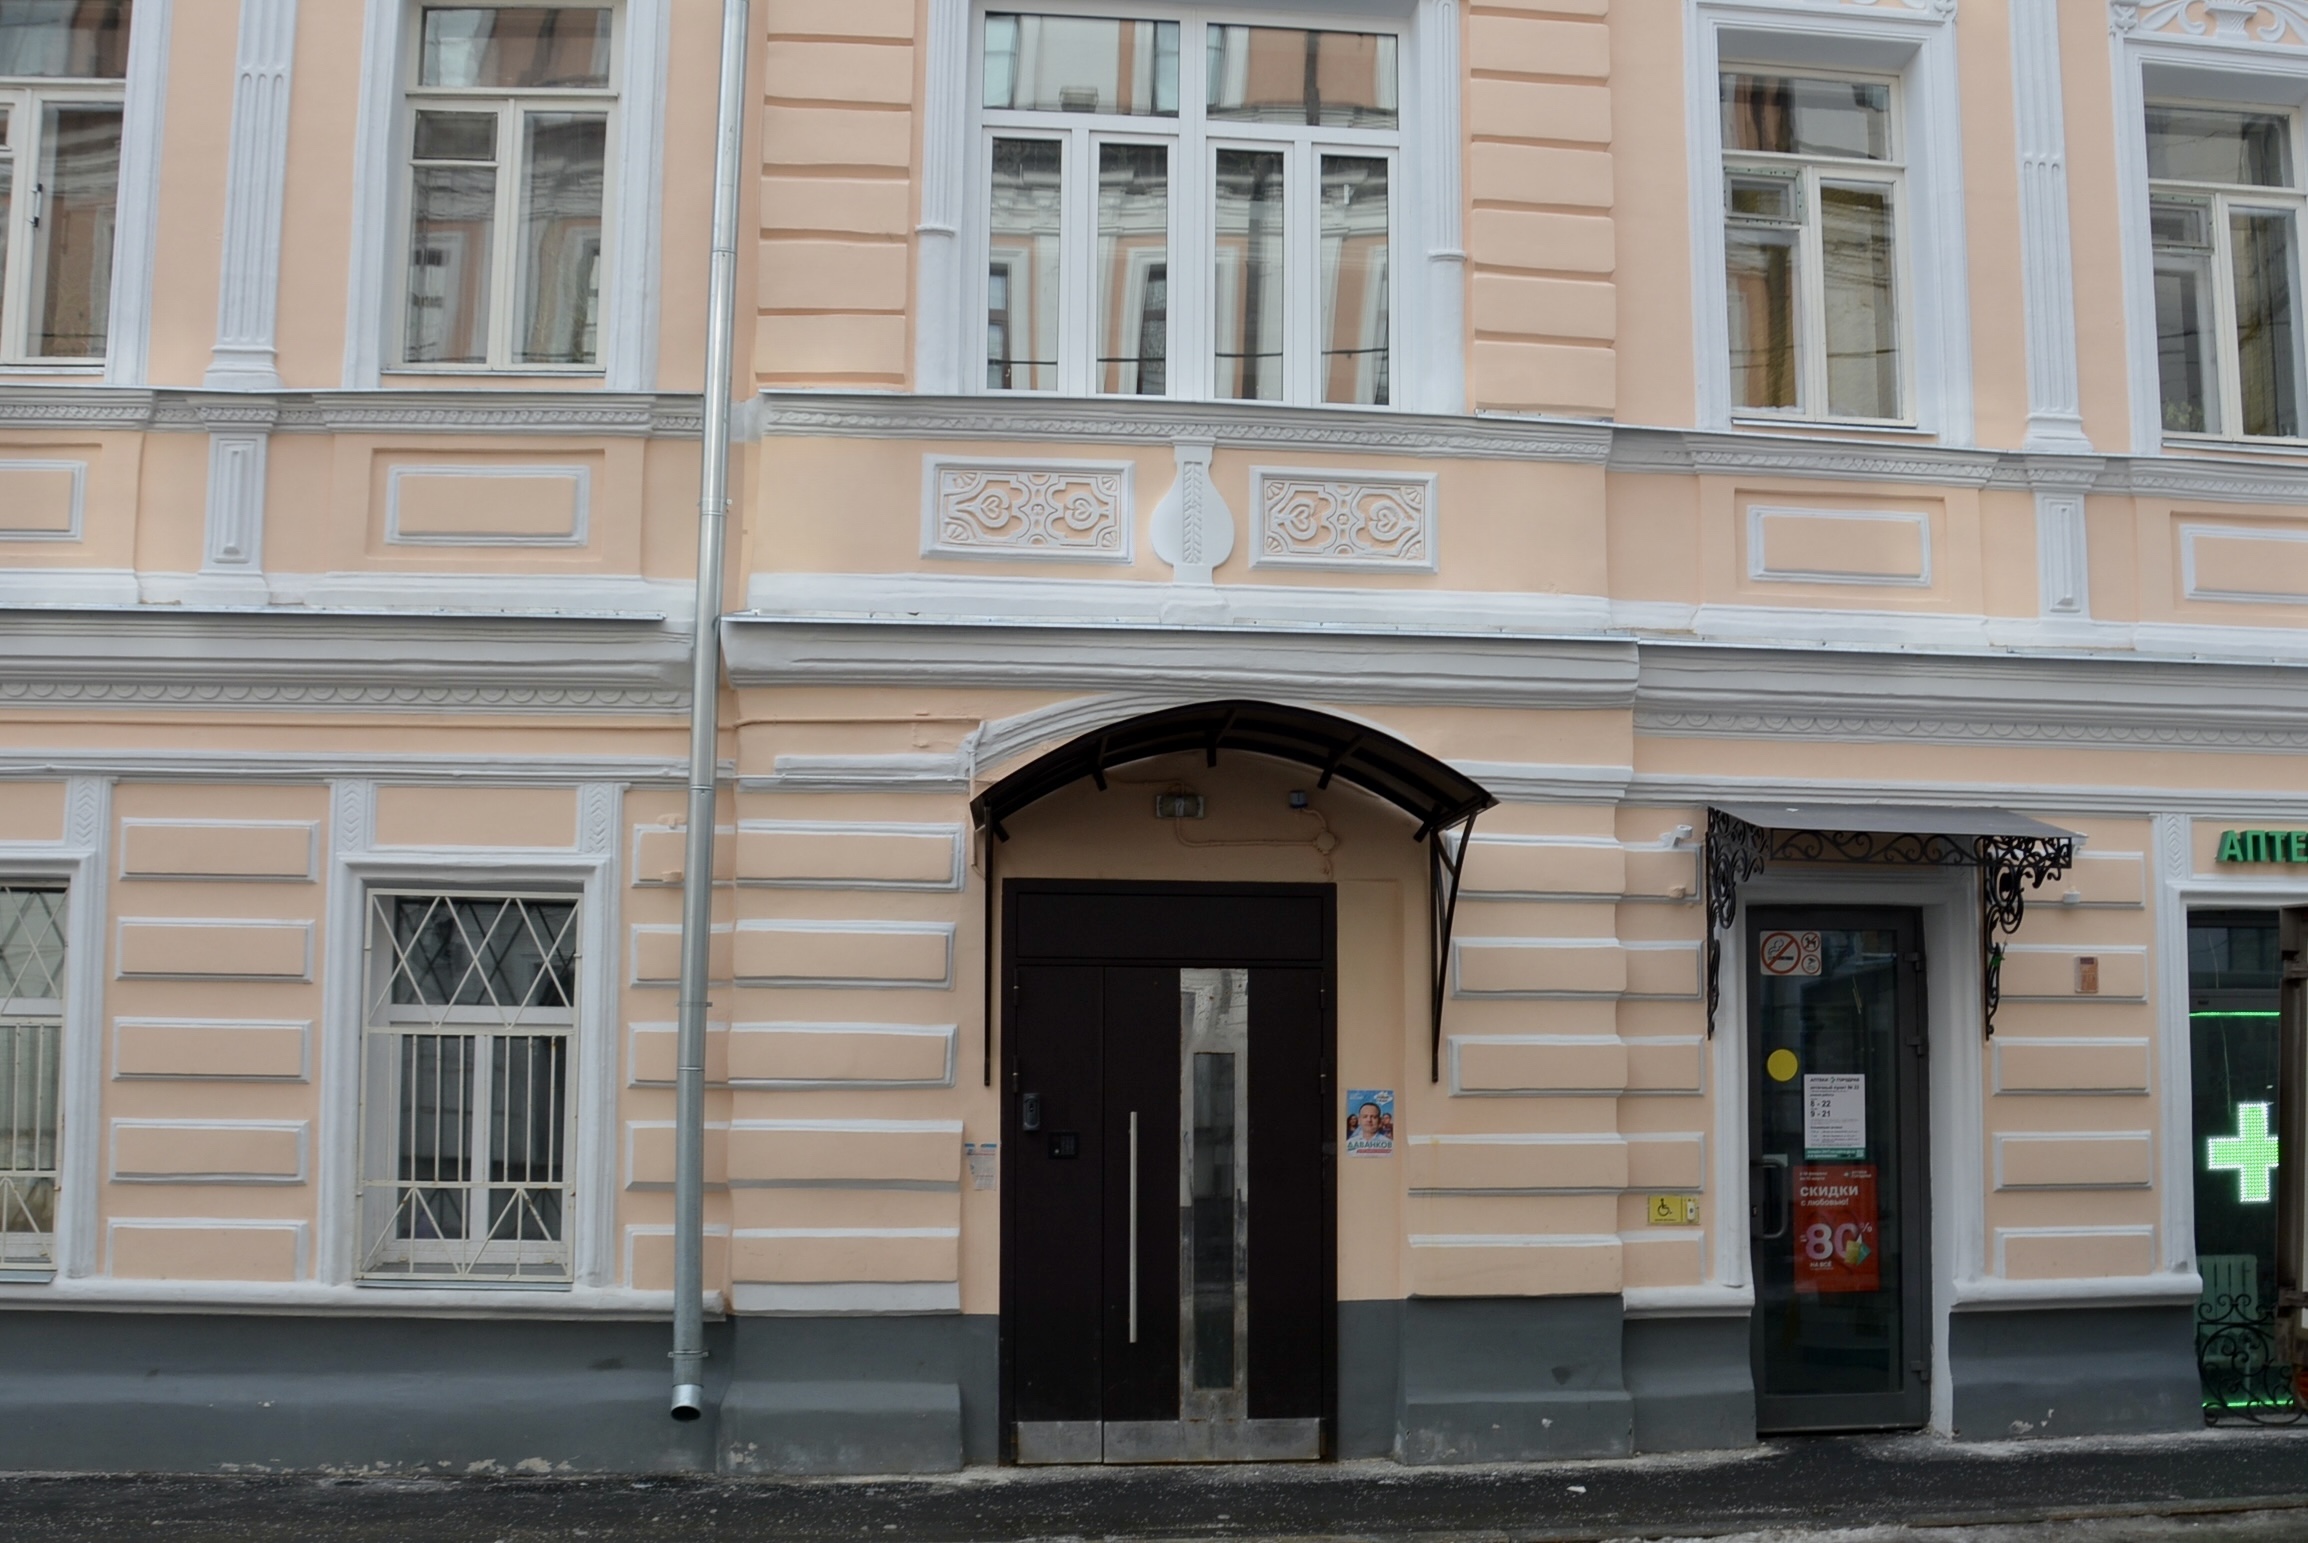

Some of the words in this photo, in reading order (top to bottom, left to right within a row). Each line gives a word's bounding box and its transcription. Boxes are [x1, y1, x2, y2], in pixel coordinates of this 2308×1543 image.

[2216, 830, 2308, 862] АПТЕ
[1347, 1141, 1393, 1150] ДАВАНКОВ
[1800, 1186, 1858, 1198] СКИДКИ
[1807, 1198, 1849, 1206] любовью!
